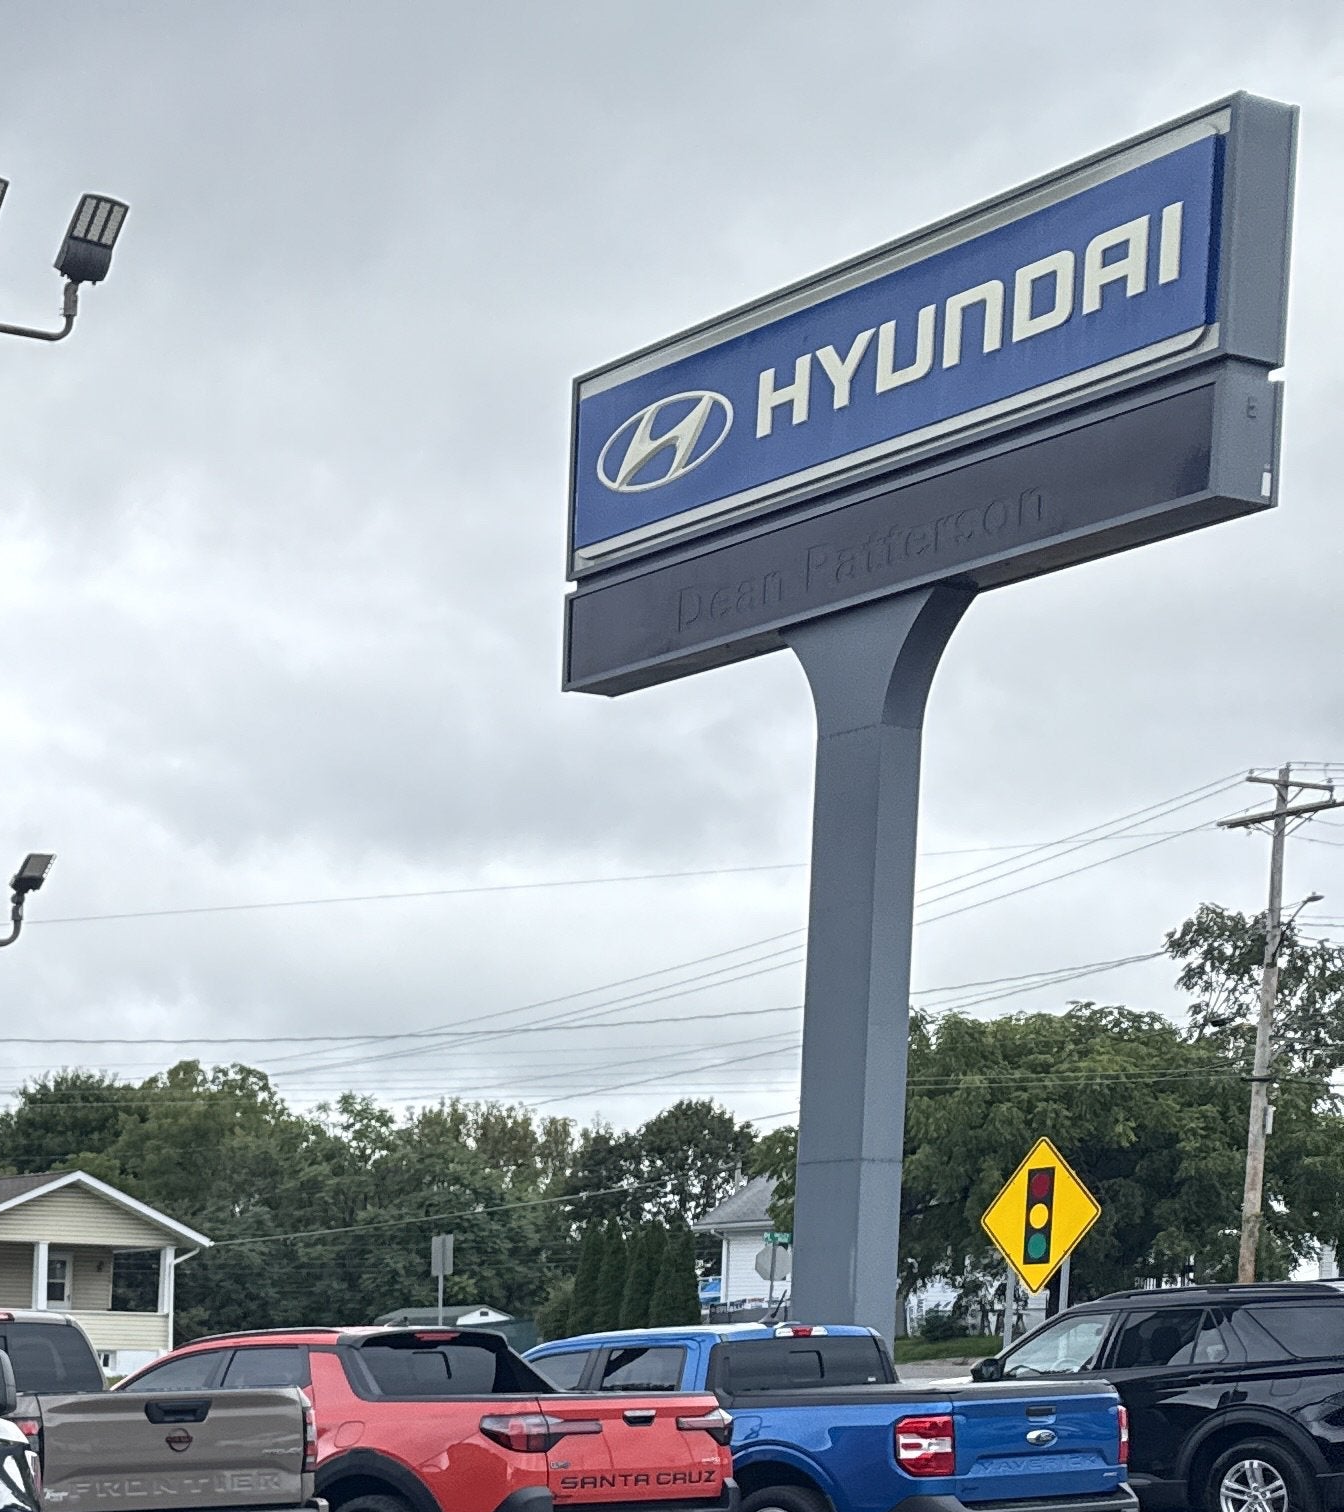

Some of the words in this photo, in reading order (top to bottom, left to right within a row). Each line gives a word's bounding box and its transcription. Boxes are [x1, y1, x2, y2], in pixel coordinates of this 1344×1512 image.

[755, 200, 1184, 439] HYUNDAI
[677, 571, 783, 632] Dean
[805, 487, 1042, 592] Patterson
[68, 1471, 282, 1500] FRONTIER
[561, 1473, 650, 1490] SANTA
[656, 1470, 716, 1486] CRUZ
